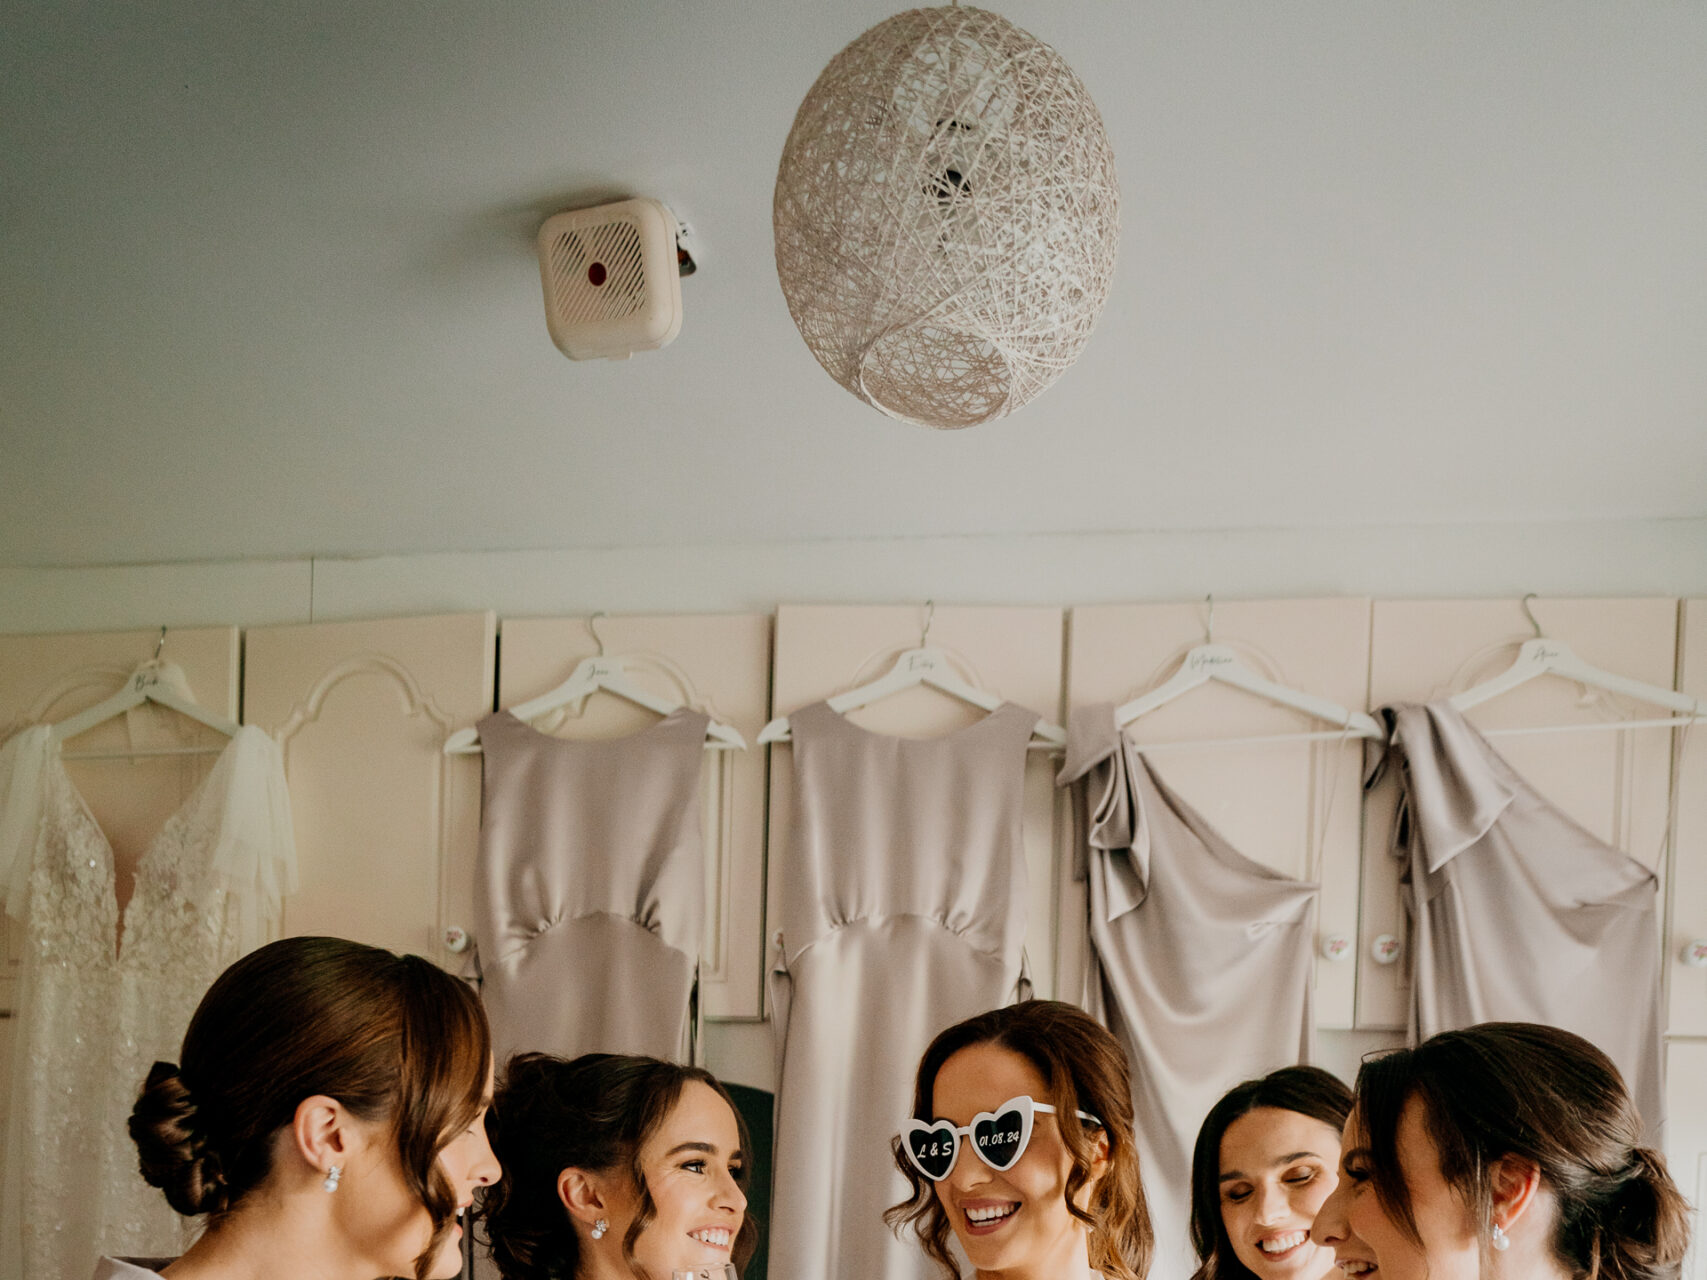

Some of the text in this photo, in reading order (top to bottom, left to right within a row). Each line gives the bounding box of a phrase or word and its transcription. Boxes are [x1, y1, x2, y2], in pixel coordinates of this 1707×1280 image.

[979, 1130, 1020, 1147] 01.08.24
[917, 1141, 953, 1159] L & S
